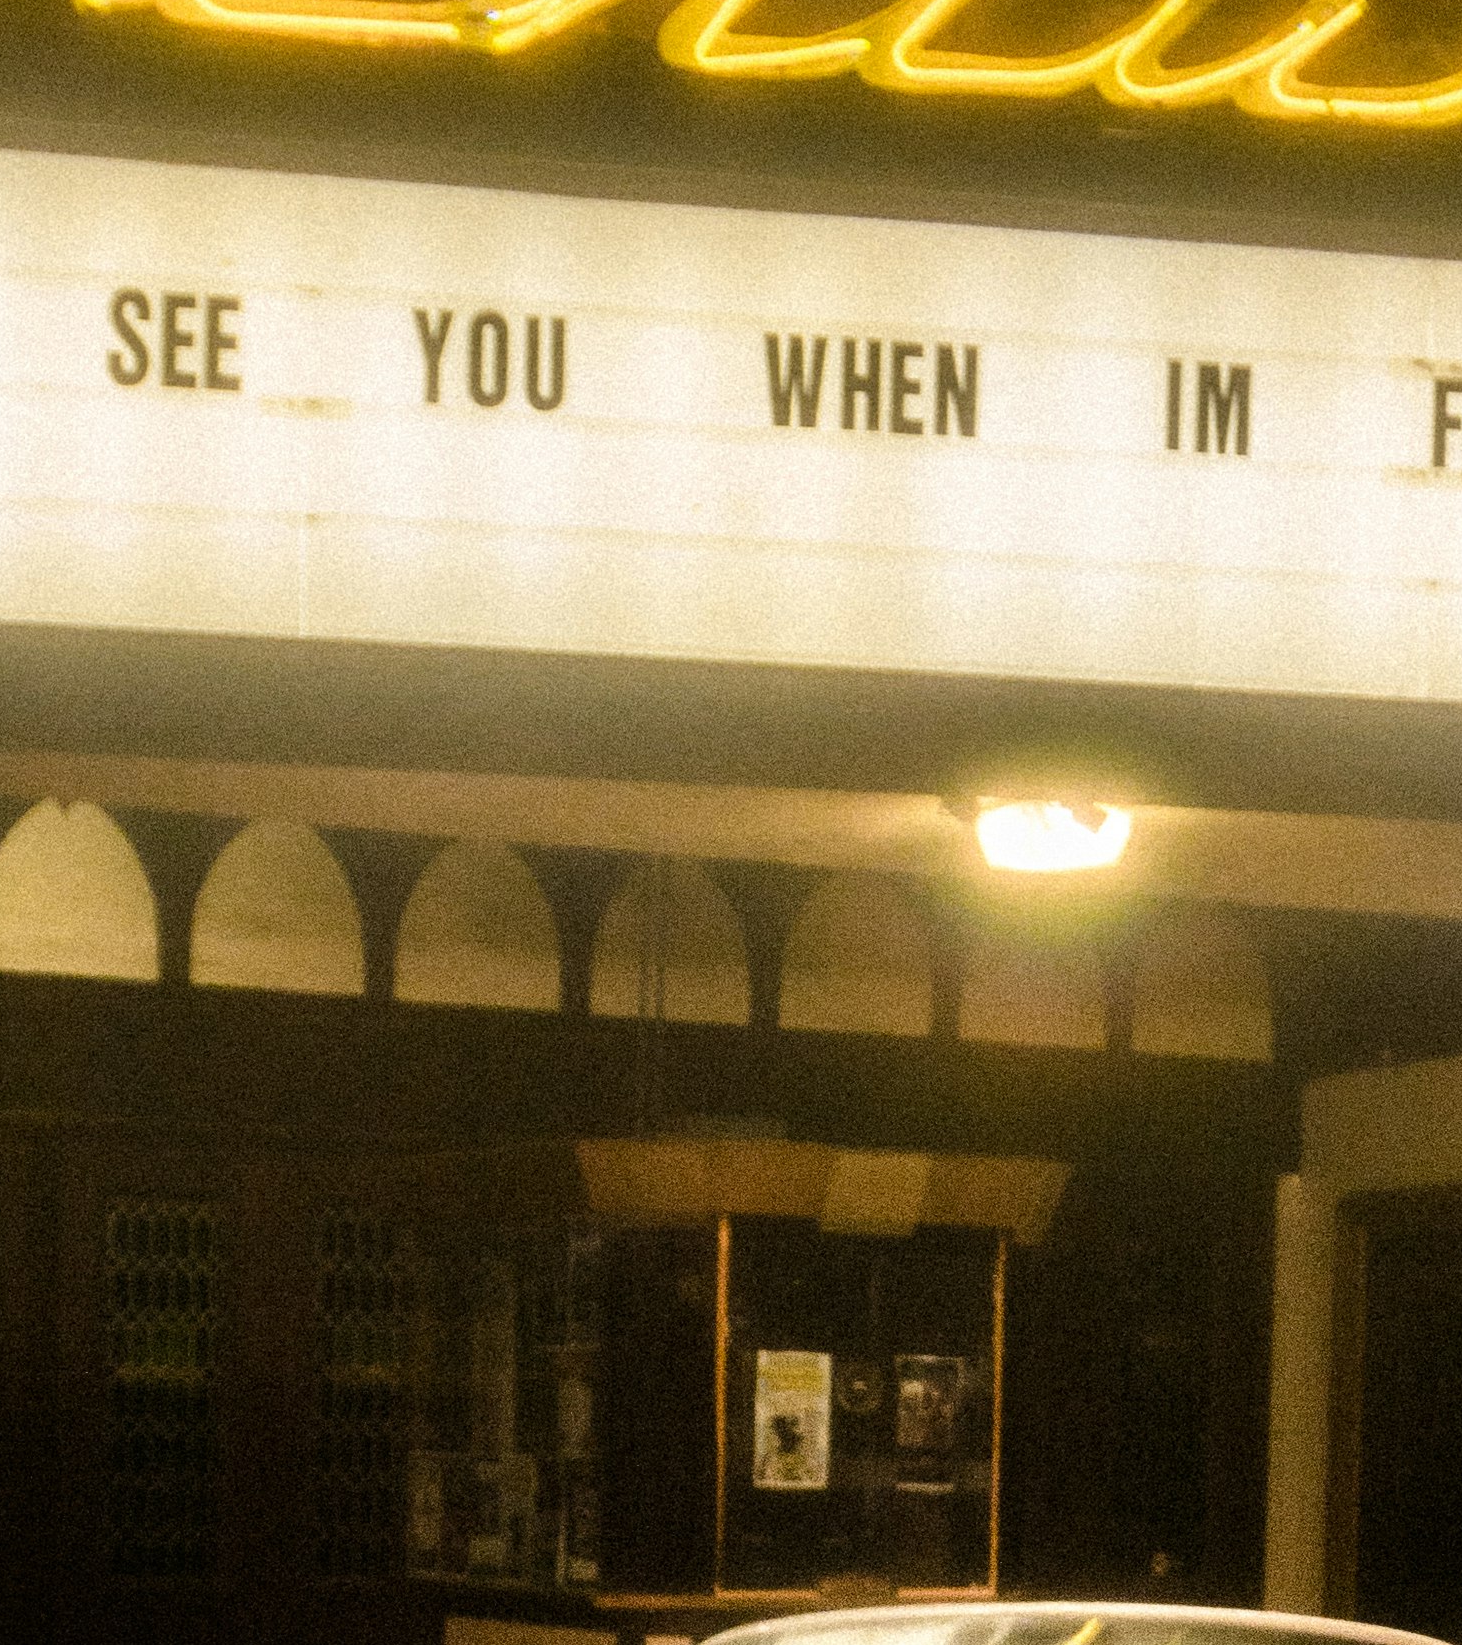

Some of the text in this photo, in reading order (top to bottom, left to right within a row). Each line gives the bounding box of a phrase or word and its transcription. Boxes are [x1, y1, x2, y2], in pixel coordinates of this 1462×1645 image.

[104, 286, 243, 392] SEE
[413, 307, 569, 412] YOU
[763, 331, 981, 439] WHEN
[1165, 358, 1254, 457] IM
